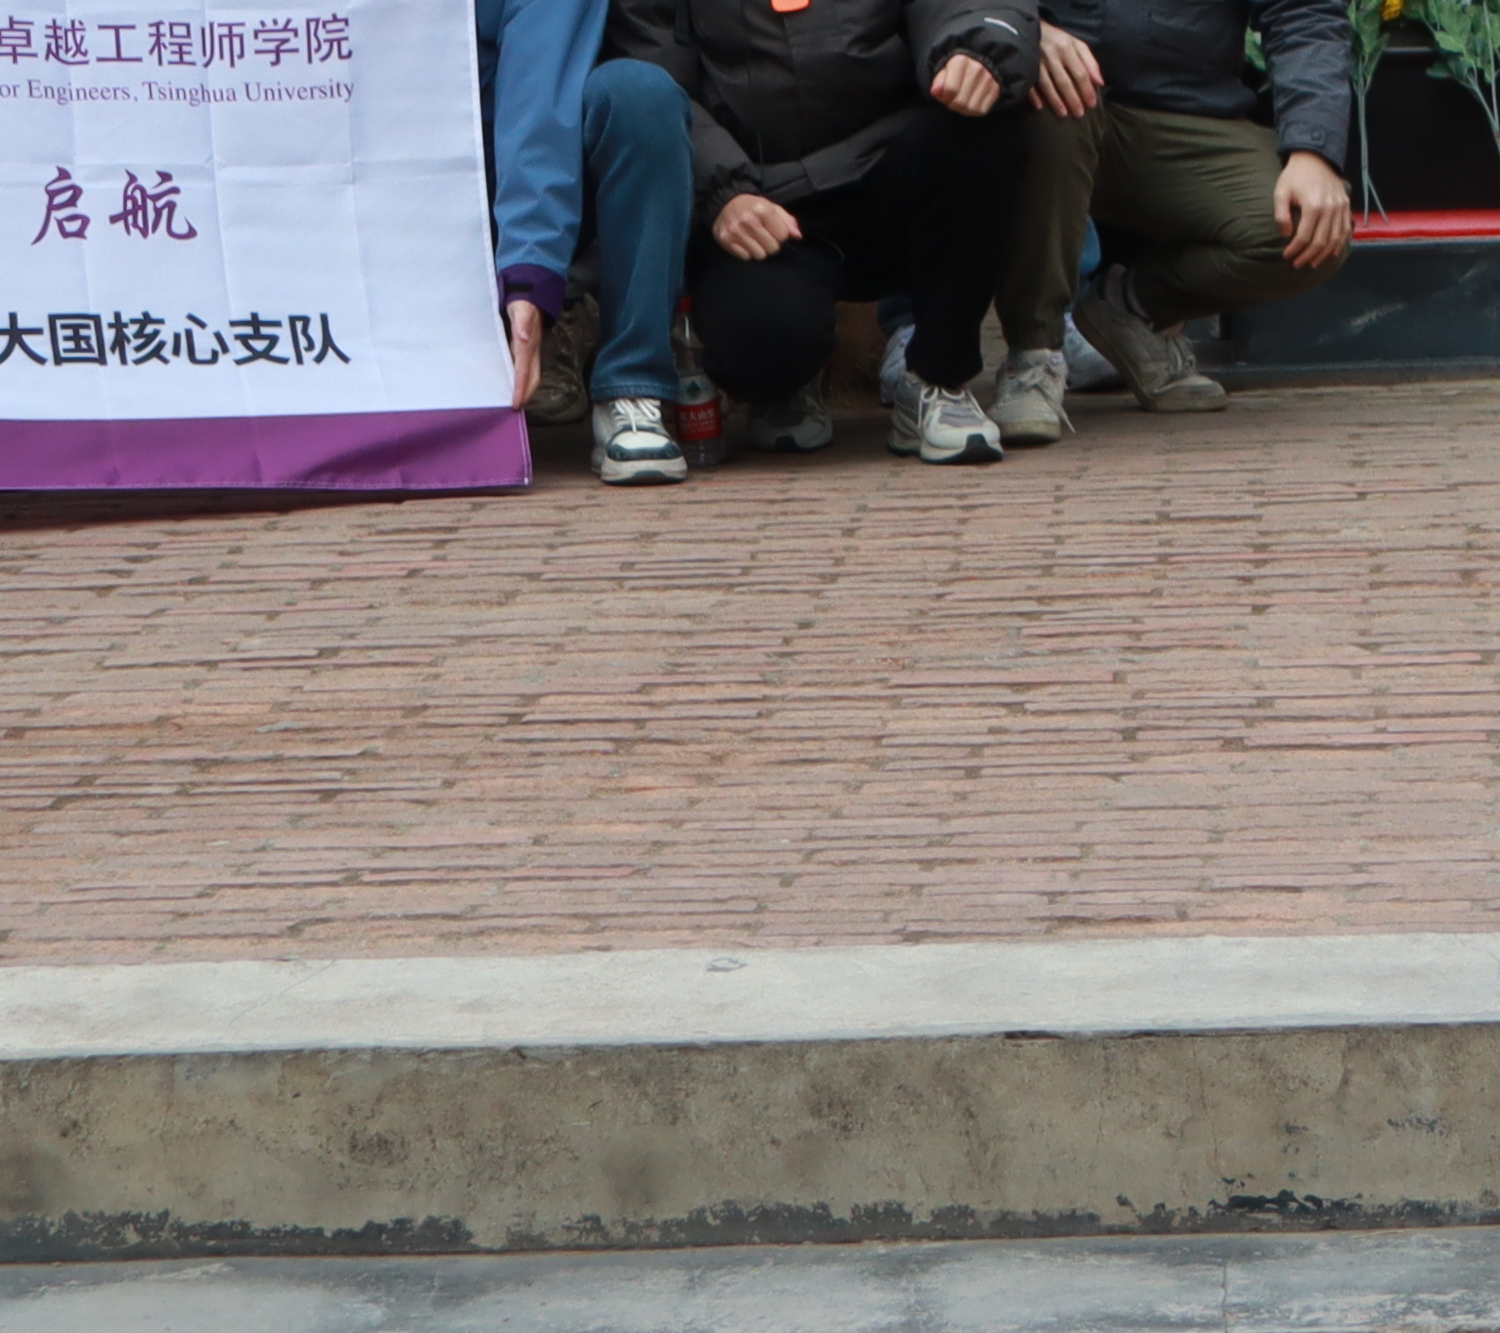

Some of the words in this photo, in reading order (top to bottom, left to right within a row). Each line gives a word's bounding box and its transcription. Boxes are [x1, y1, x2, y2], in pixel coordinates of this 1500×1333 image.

[27, 79, 139, 106] Engineers,
[142, 80, 238, 107] Tsinghua
[244, 78, 356, 104] University
